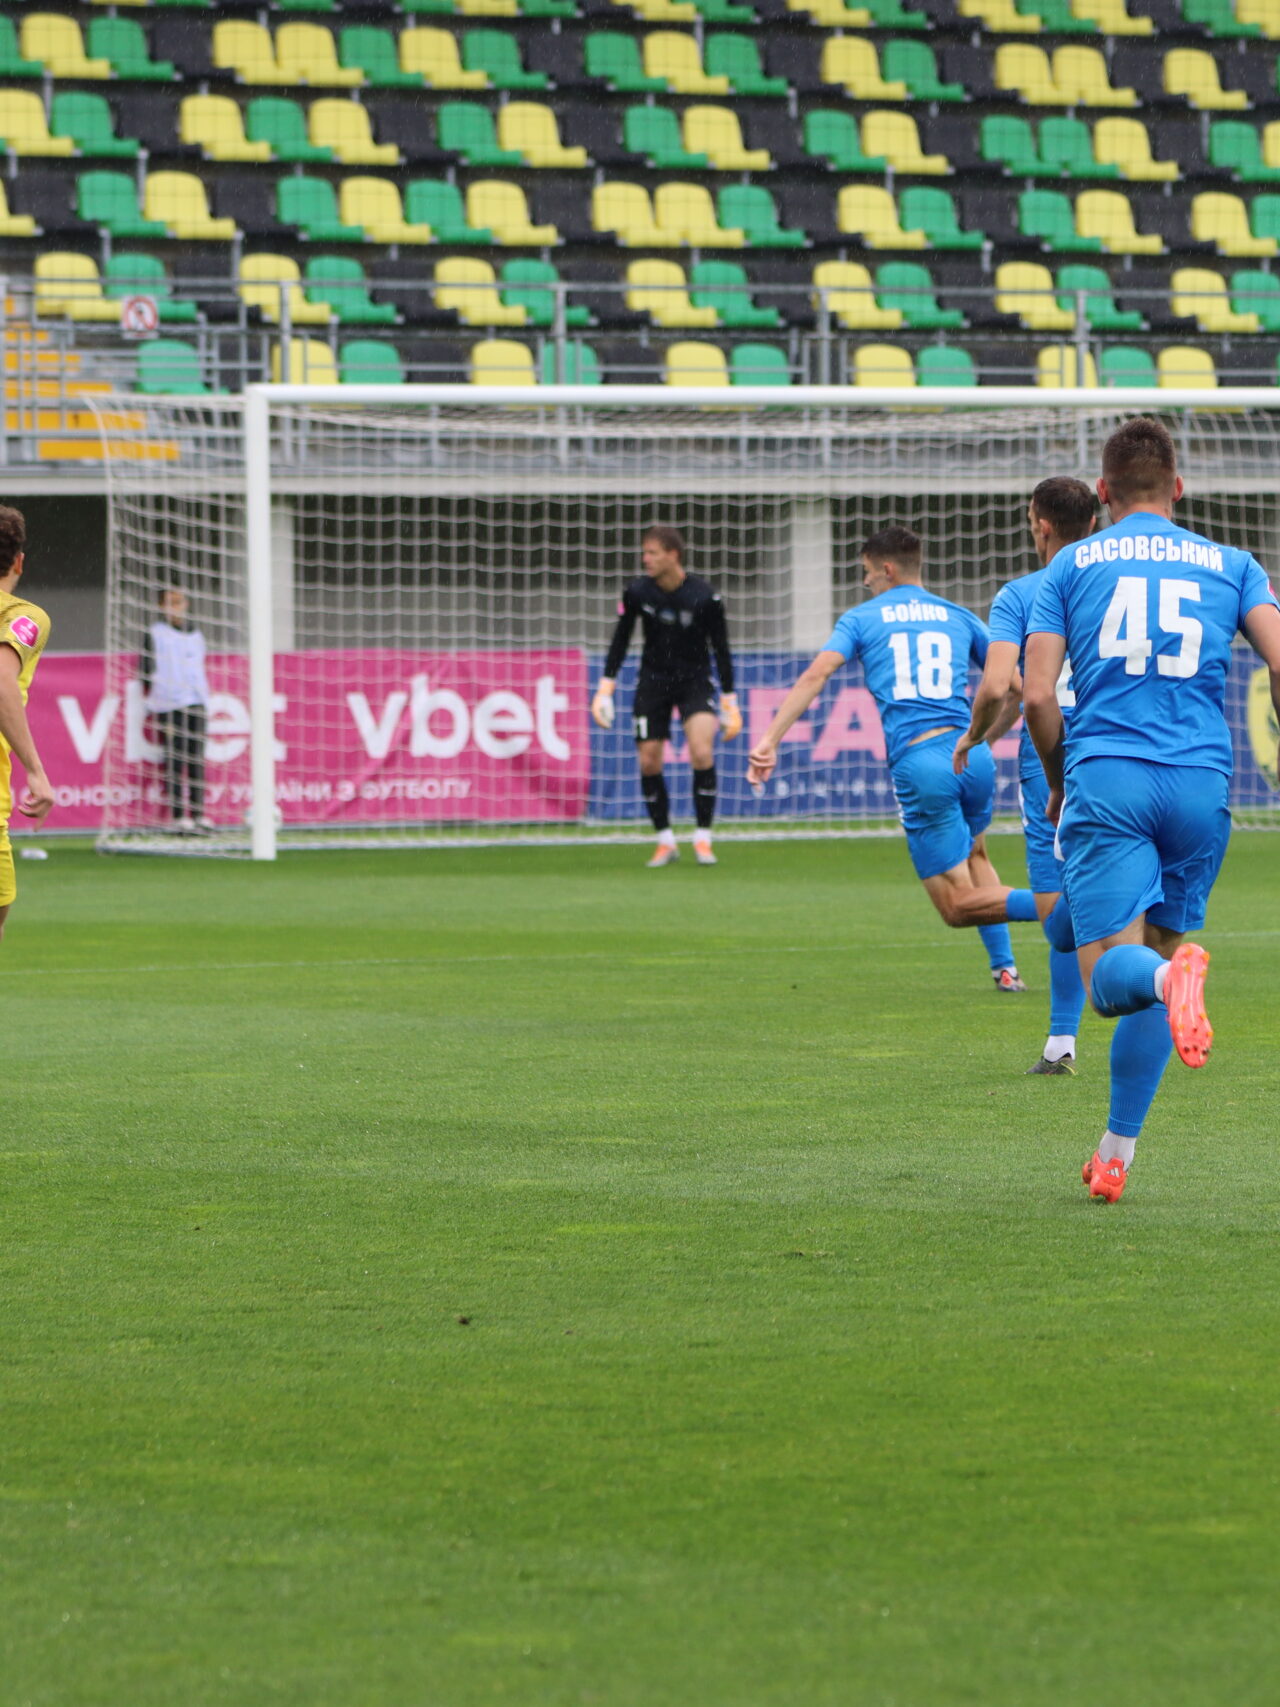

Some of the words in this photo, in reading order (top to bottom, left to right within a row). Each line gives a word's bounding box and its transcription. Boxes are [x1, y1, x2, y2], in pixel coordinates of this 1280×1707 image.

[1075, 534, 1224, 572] САСОВСЬКИЙ
[881, 599, 948, 623] БОЙКО
[1099, 576, 1203, 679] 45
[888, 631, 953, 700] 18
[346, 672, 571, 761] vbet
